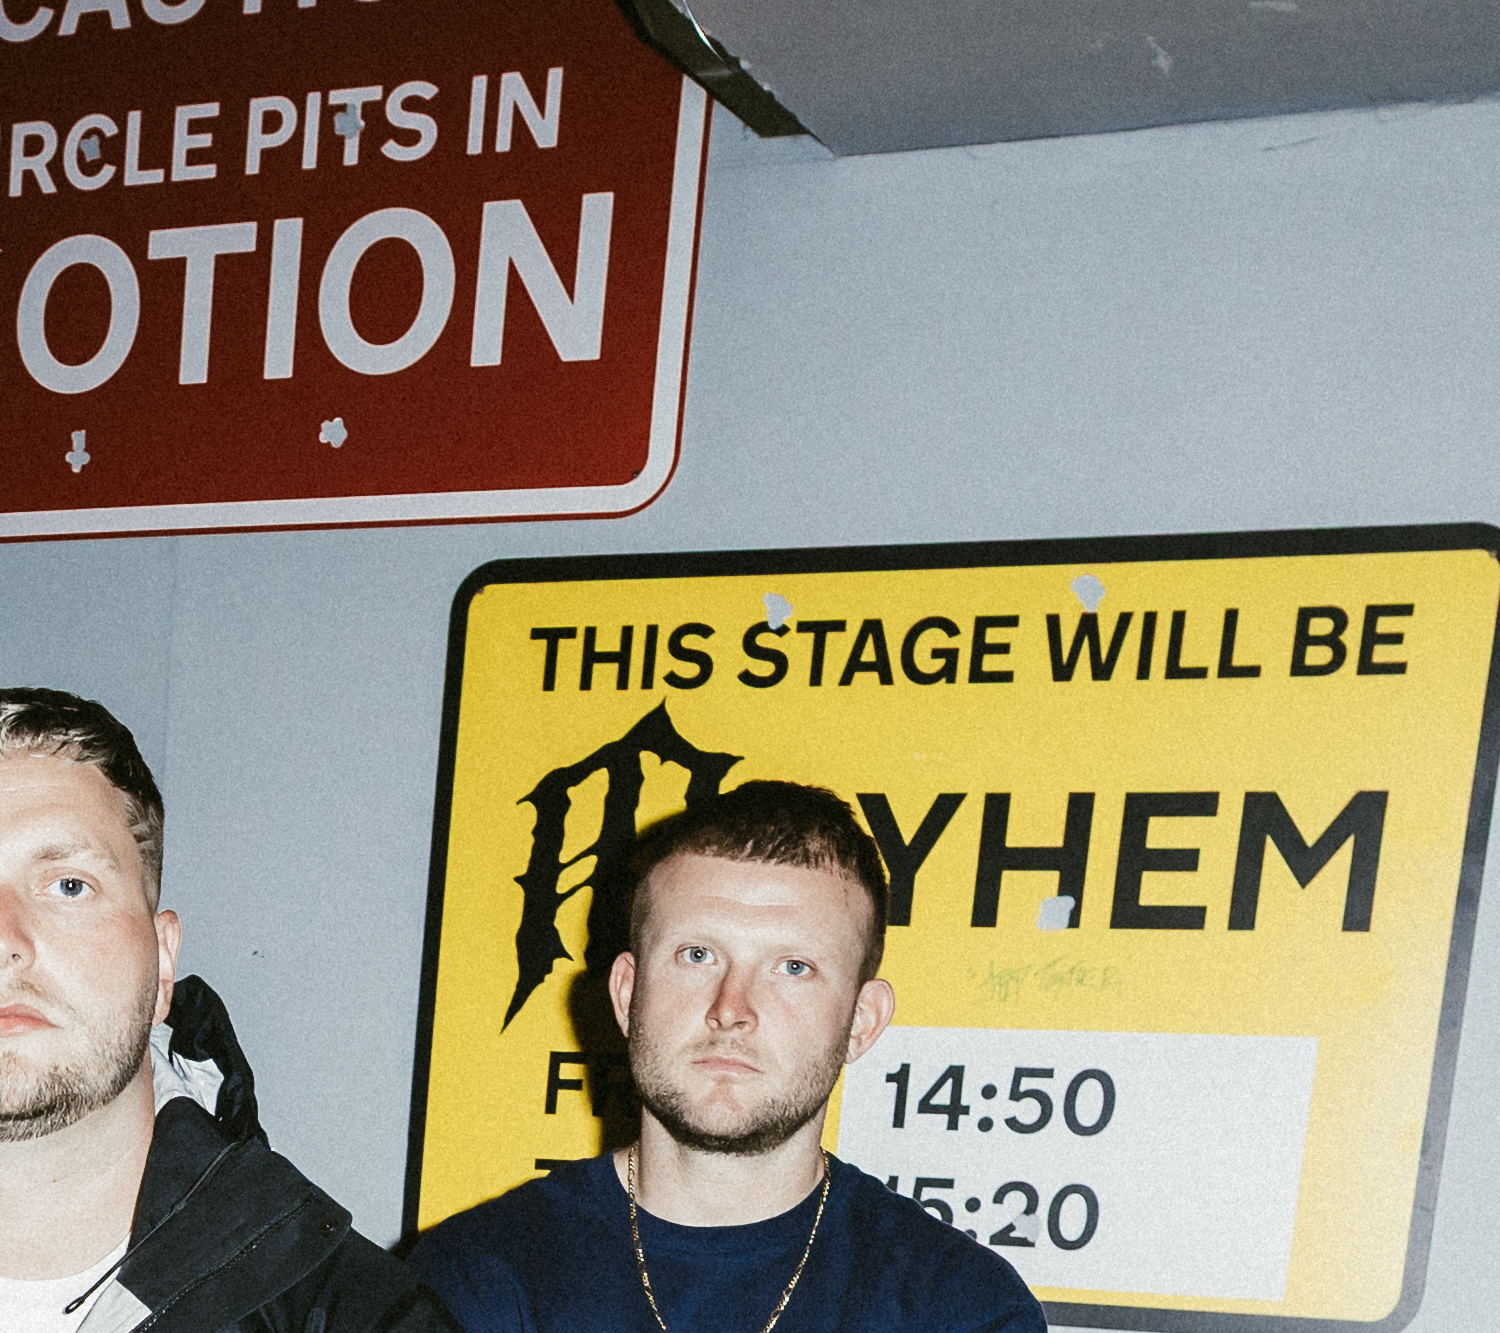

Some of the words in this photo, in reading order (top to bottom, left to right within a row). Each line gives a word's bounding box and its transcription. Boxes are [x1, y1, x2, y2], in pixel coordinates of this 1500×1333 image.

[244, 81, 440, 175] PITS
[465, 67, 563, 156] IN
[530, 623, 714, 692] THIS
[737, 613, 1021, 691] STAGE
[1045, 606, 1265, 683] WILL
[1290, 603, 1415, 678] BE
[500, 698, 1390, 1034] MYHEM
[885, 1063, 1116, 1136] 14:50
[885, 1175, 1099, 1251] 5:20
